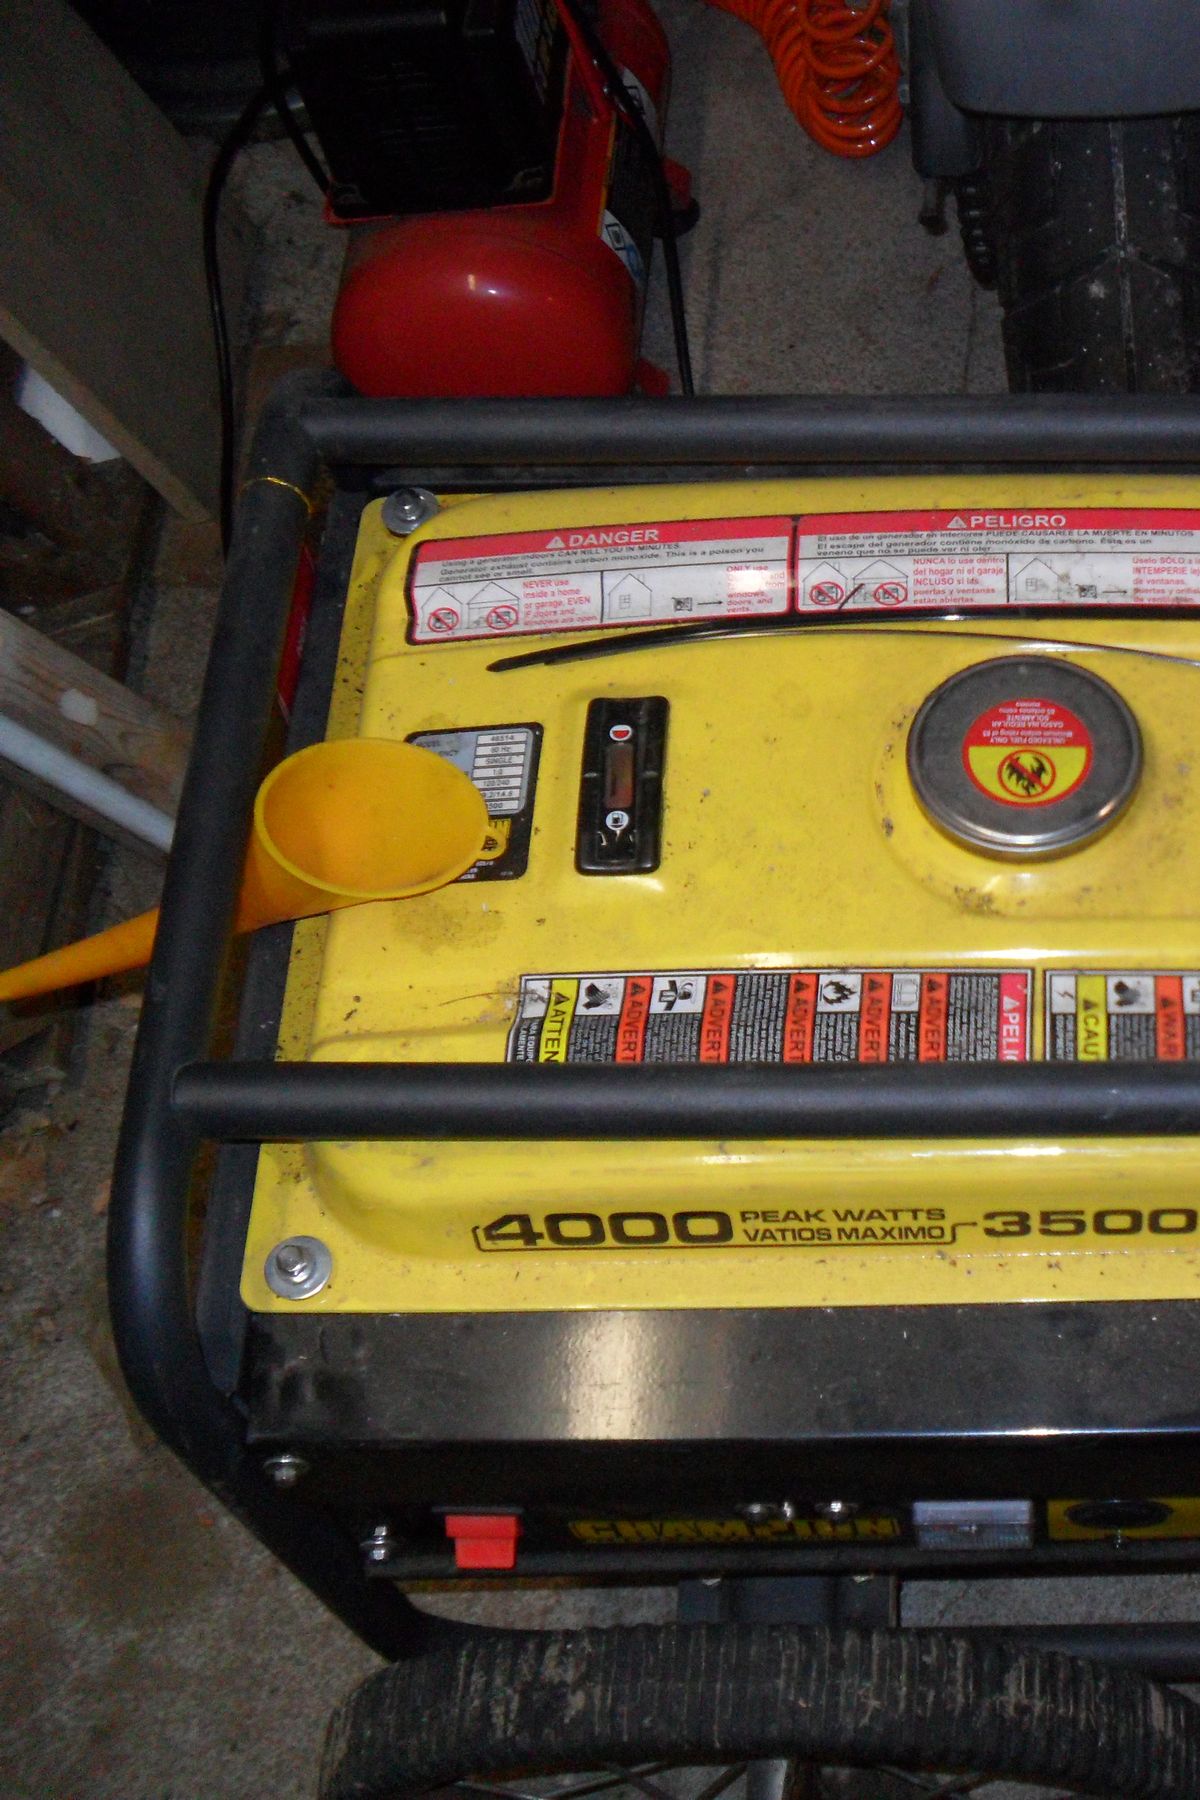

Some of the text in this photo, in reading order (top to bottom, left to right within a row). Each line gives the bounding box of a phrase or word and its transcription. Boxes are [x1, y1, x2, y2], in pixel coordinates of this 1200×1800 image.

[970, 514, 1066, 528] PELIGRO
[568, 529, 660, 547] DANGER
[877, 532, 924, 541] generador
[886, 540, 937, 549] generador
[665, 550, 686, 558] This
[709, 548, 743, 557] poison
[745, 547, 764, 555] you
[856, 549, 875, 557] que
[913, 557, 946, 565] NUNCA
[913, 567, 926, 575] del
[928, 567, 954, 577] hogar
[522, 579, 553, 589] NEVER
[913, 577, 955, 585] INCLUSO
[739, 1207, 946, 1224] PEAK WATTS
[483, 1209, 735, 1247] 4000
[982, 1208, 1198, 1238] 3500
[742, 1224, 946, 1243] VATIOS MAXIMO
